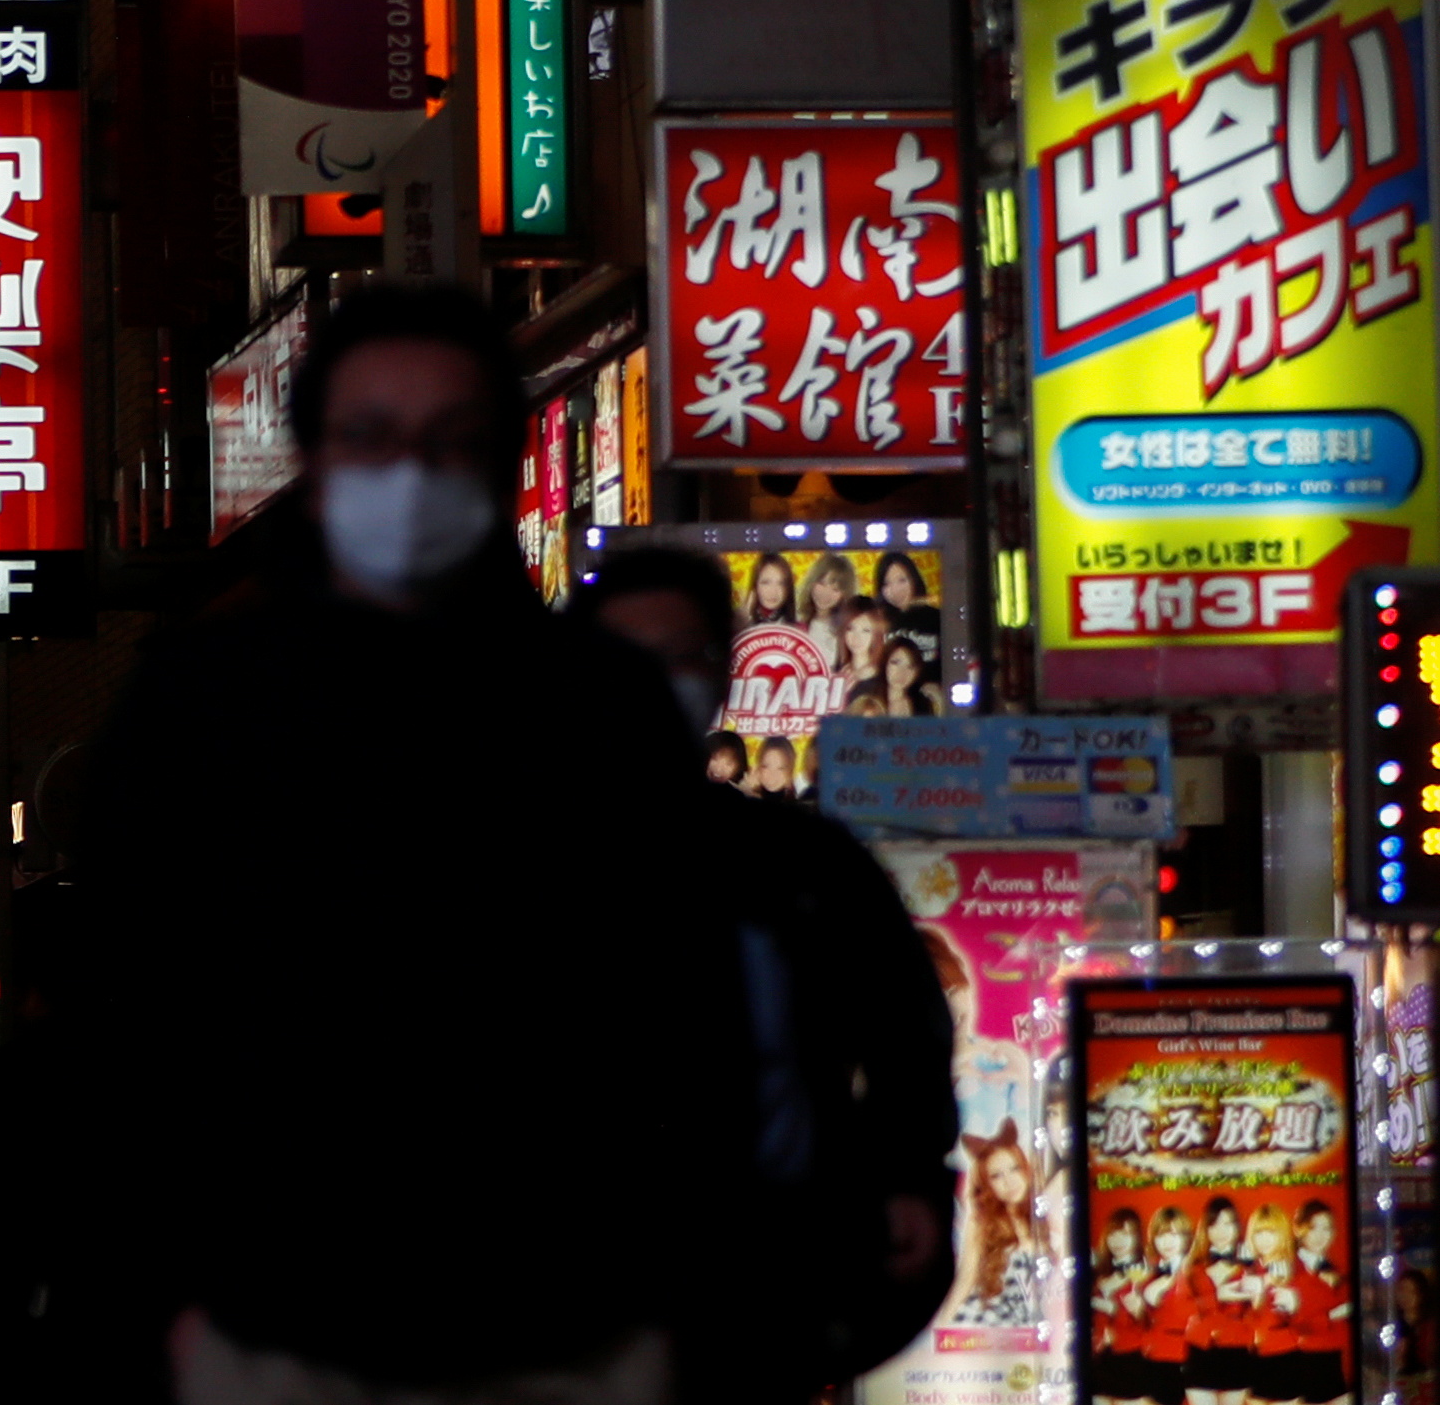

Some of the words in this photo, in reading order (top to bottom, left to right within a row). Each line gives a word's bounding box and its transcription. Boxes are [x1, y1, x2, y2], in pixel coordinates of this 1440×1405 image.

[386, 33, 412, 101] 2020
[683, 131, 966, 303] 湖南
[1053, 25, 1397, 333] 出会い
[1199, 211, 1416, 389] カフェ
[683, 305, 912, 451] 菜館
[1078, 573, 1314, 633] 受付3F
[972, 867, 1036, 894] Aroma
[1101, 1101, 1320, 1155] 飲み放題
